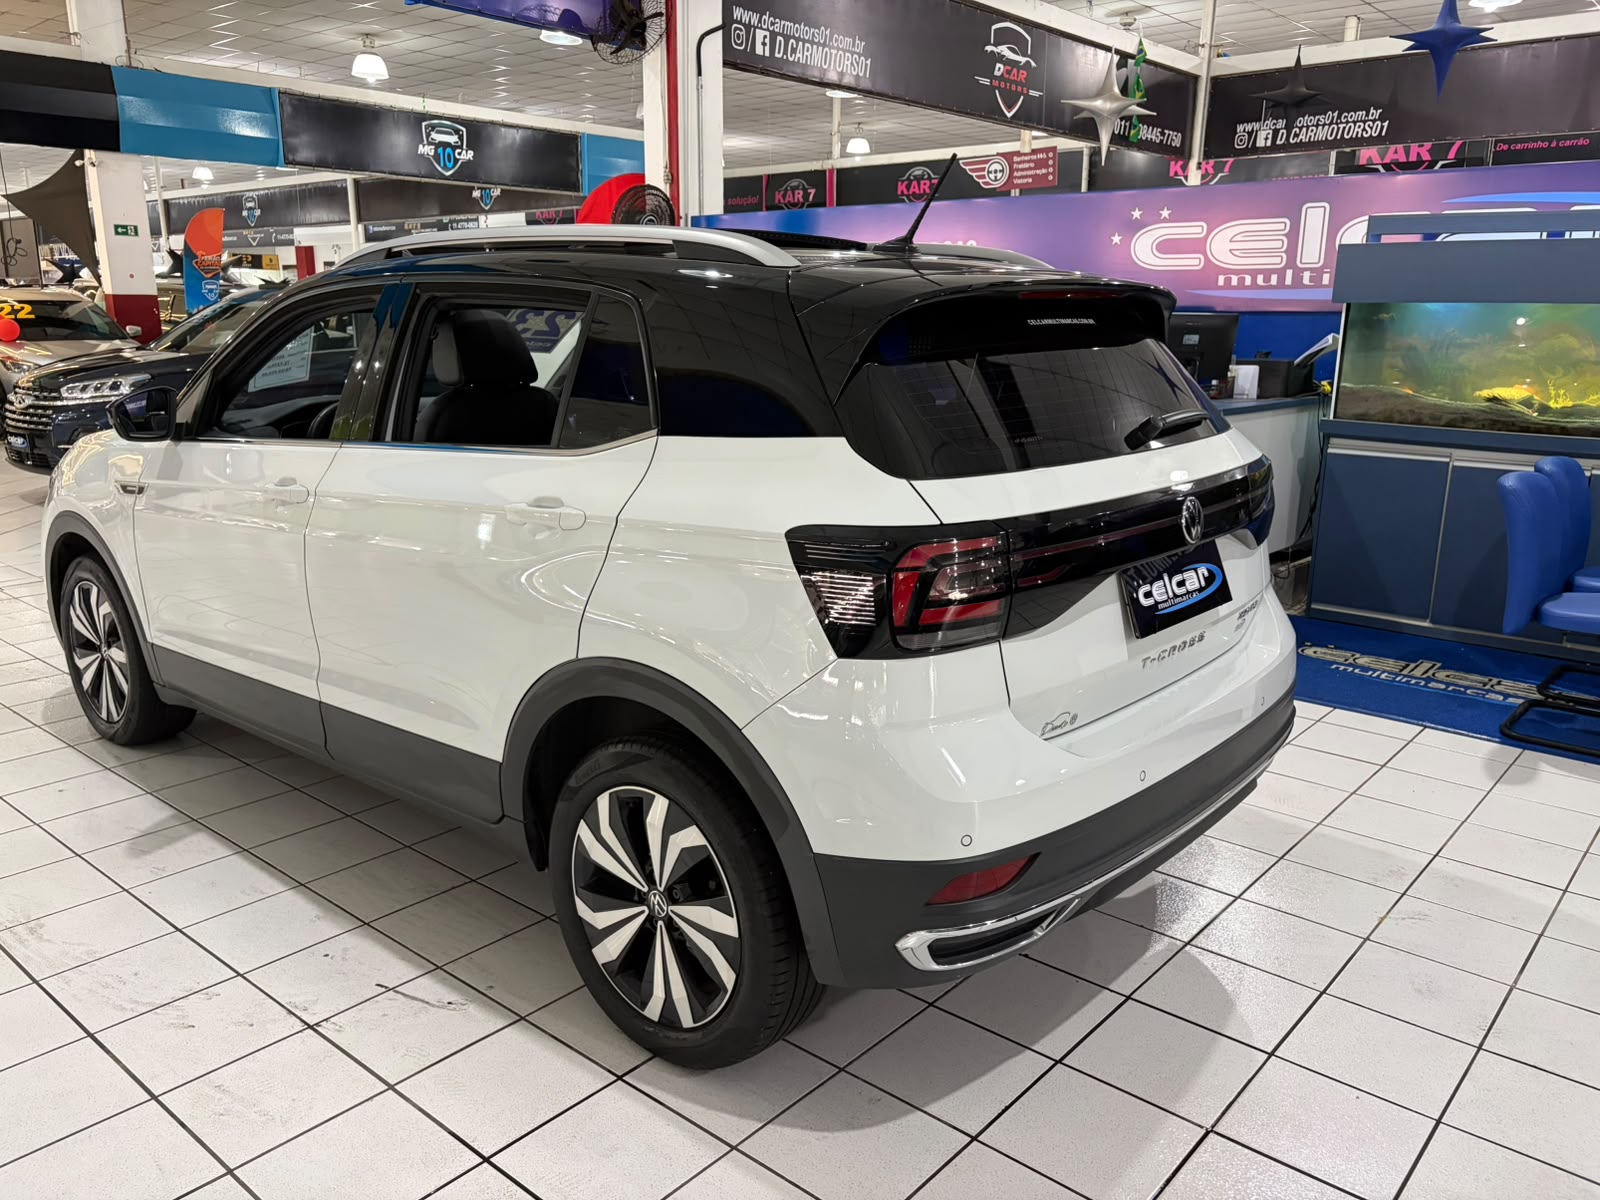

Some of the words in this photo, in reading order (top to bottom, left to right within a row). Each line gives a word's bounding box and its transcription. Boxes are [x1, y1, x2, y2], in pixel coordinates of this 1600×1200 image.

[733, 5, 865, 53] www.dcarmotors01.com.br
[775, 36, 871, 78] D.CARMOTORS01
[994, 62, 1028, 83] DCAR
[991, 79, 1028, 94] MOTORS
[1114, 119, 1130, 136] 011
[1496, 142, 1508, 151] De
[1510, 141, 1549, 150] carrinho
[1559, 138, 1590, 147] carrão
[418, 144, 435, 156] MG
[437, 147, 454, 169] 10
[455, 149, 474, 161] CAR
[1169, 160, 1215, 177] KR
[775, 190, 804, 204] KAR
[808, 189, 816, 202] 7
[896, 179, 930, 196] KAR
[1137, 566, 1209, 607] celcar
[1158, 590, 1200, 610] multimarcas
[1141, 631, 1206, 669] T-CROSS
[1298, 646, 1600, 706] celca
